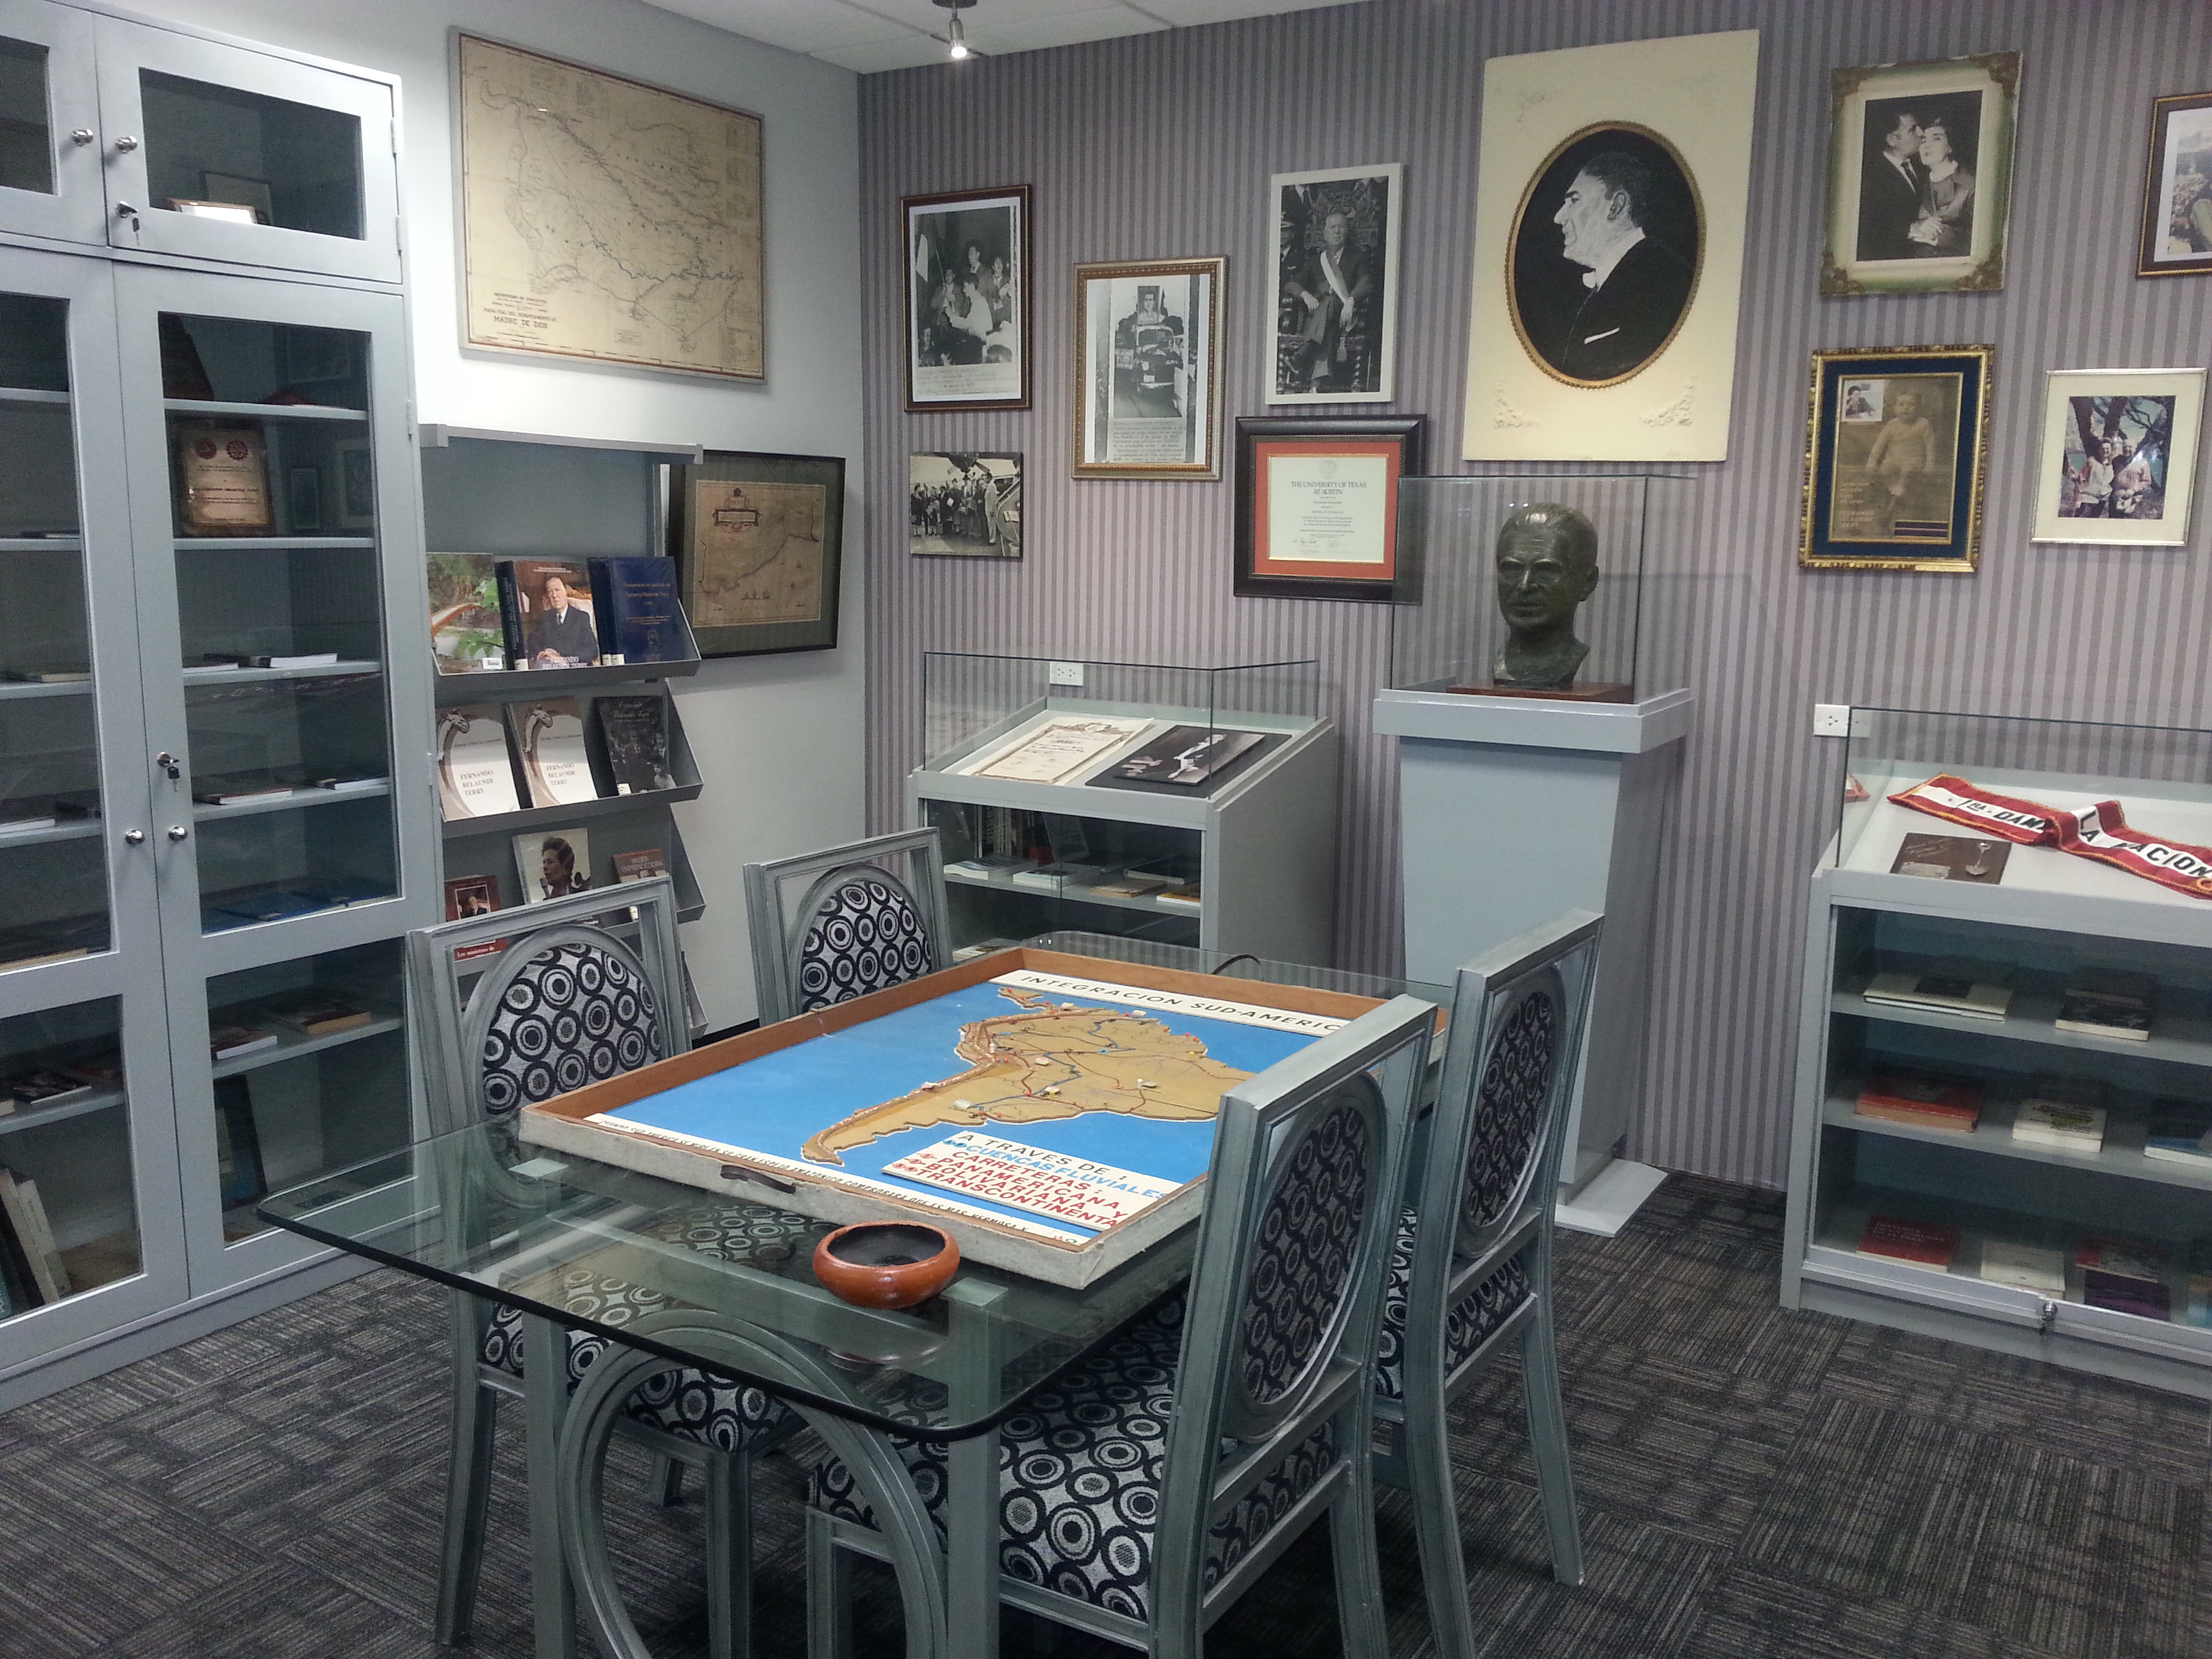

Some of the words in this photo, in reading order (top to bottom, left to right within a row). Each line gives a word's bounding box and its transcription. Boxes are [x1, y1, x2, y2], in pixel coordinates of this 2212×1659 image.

[493, 315, 518, 325] MADRE
[533, 321, 548, 329] DIOS
[460, 769, 493, 780] FERNANDO
[546, 762, 575, 771] FERNANDO
[548, 770, 576, 779] BELAUNDE
[462, 779, 495, 788] BELAUNDE
[464, 788, 484, 796] TERRY
[2080, 810, 2100, 842] LA
[1021, 976, 1183, 1005] INTEGRACION
[985, 1139, 1072, 1165] TRAVES
[937, 1158, 1120, 1209] PANAMERICANA
[966, 1145, 1055, 1170] CUENCAS
[1054, 1167, 1168, 1200] FLUVIALES
[792, 1167, 843, 1184] AMAZONICO
[909, 1196, 929, 1206] QUE
[925, 1163, 1086, 1210] BOLIVARIANA
